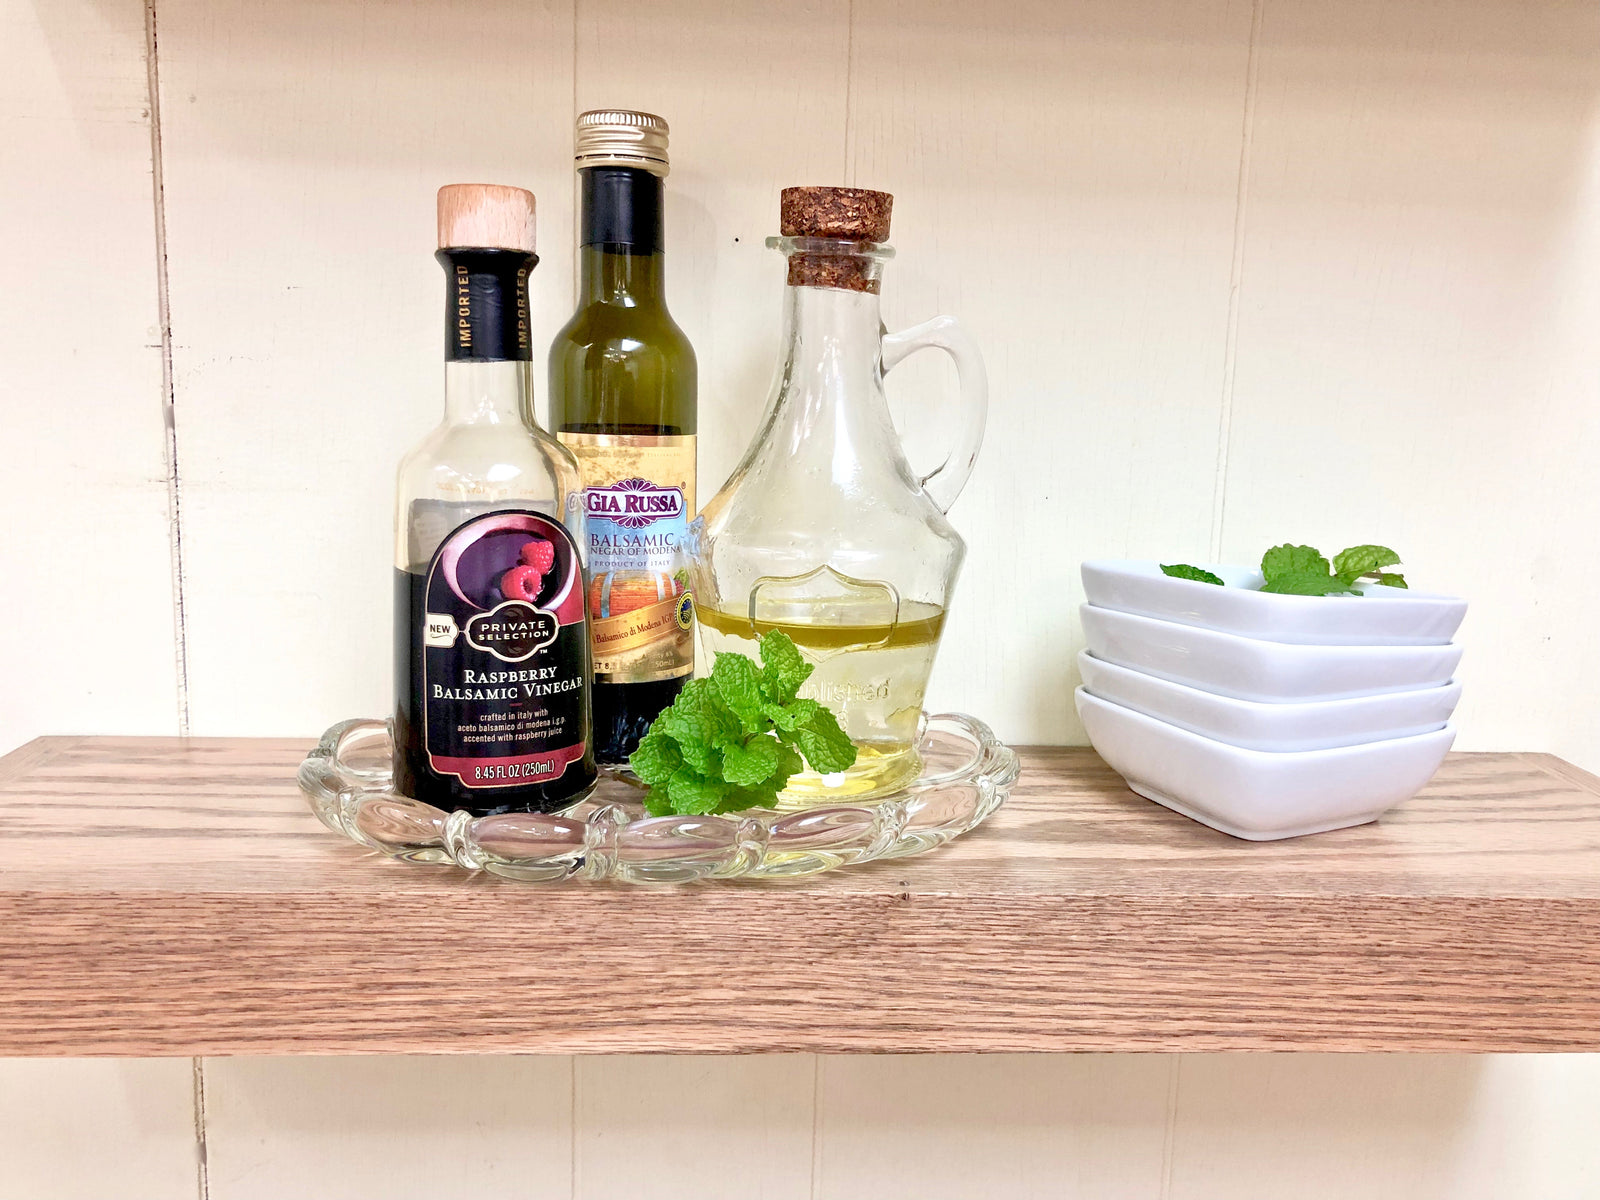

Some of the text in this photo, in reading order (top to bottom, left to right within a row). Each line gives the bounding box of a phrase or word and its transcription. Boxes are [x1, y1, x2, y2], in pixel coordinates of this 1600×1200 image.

[457, 265, 472, 347] IMPORTED
[517, 268, 528, 349] IMPORTED
[587, 492, 678, 513] GIA RUSSA
[591, 533, 674, 547] BALSAMIC
[590, 546, 623, 556] NEGAR
[627, 547, 640, 556] OF
[650, 559, 671, 567] ITALY
[430, 623, 451, 634] NEW
[481, 620, 546, 632] PRIVATE
[596, 631, 629, 644] Balsamico
[629, 626, 637, 636] di
[637, 620, 662, 634] Modena
[479, 630, 549, 641] SELECTION
[464, 666, 558, 684] RASPBERRY
[433, 676, 583, 700] BALSAMIC VINEGAR
[799, 678, 891, 702] blished
[480, 708, 549, 721] crafted in italy with
[457, 724, 477, 732] aceto
[478, 722, 515, 732] balsamico
[517, 721, 524, 729] di
[525, 719, 551, 729] modena
[463, 727, 563, 743] accented with raspberry juice
[475, 759, 555, 779] 8.45 FL OZ (250mL)
